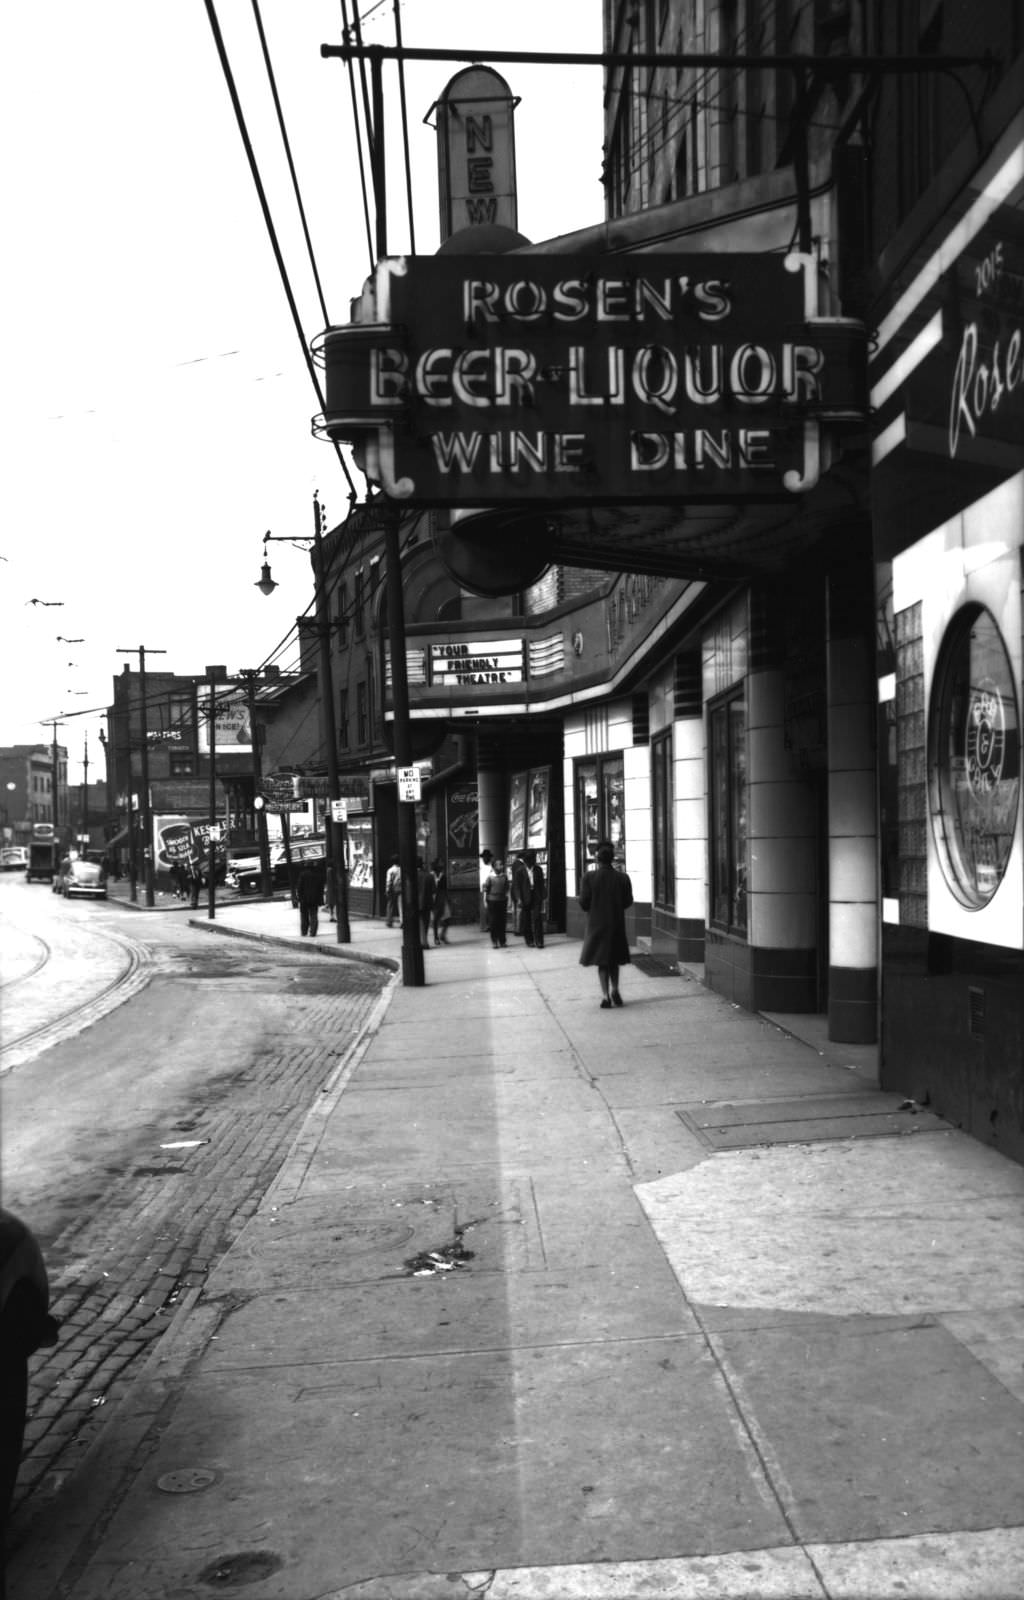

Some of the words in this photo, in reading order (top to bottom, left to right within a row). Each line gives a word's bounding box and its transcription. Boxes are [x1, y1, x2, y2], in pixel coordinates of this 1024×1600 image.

[465, 115, 499, 224] NEW
[974, 241, 1004, 297] 2015
[462, 276, 734, 323] ROSEN'S
[368, 344, 537, 408] BEER
[568, 342, 826, 416] LIQUOR
[949, 323, 1024, 460] Rose
[430, 428, 588, 474] WINE
[629, 426, 777, 473] DINE
[447, 657, 498, 670] FRIENDLY
[193, 821, 236, 837] KESLER
